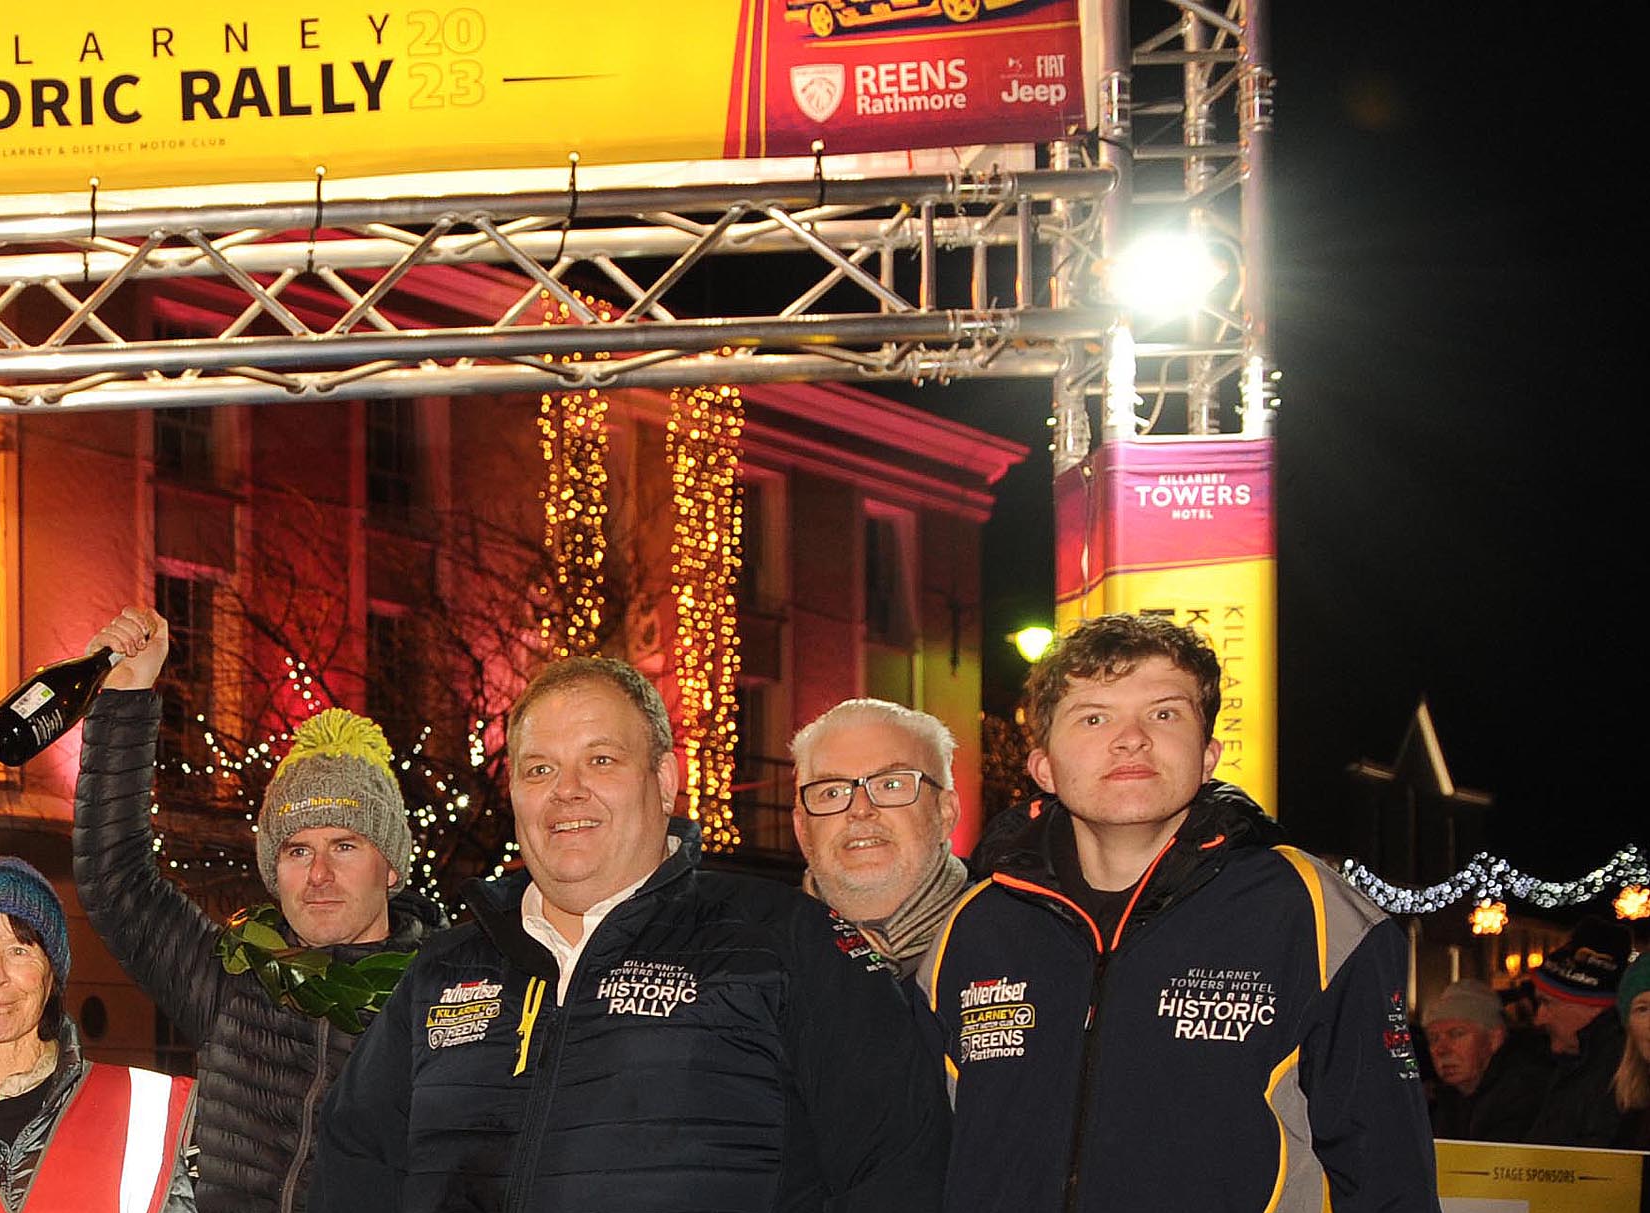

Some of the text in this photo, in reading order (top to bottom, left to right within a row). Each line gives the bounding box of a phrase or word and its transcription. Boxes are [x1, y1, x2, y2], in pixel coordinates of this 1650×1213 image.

[854, 58, 969, 95] REENS
[180, 58, 395, 121] RALLY
[1001, 79, 1068, 106] Jeep
[855, 92, 968, 116] Rathmore
[139, 139, 186, 151] MOTOR
[191, 138, 227, 148] CLUB
[1158, 472, 1226, 485] KILLARNEY
[1134, 484, 1252, 508] TOWERS
[1171, 508, 1214, 520] HOTEL
[1221, 605, 1245, 772] KILLARNEY
[623, 959, 686, 972] KILLARNEY
[1188, 967, 1262, 981] KILLARNEY
[658, 971, 697, 981] HOTEL
[1169, 977, 1275, 994] TOWERS HOTEL
[596, 981, 698, 1004] HISTORIC
[1160, 988, 1277, 1006] KILLARNEY
[607, 997, 678, 1018] RALLY
[1157, 998, 1276, 1026] HISTORIC
[971, 1029, 1025, 1049] REENS
[1174, 1019, 1254, 1042] RALLY
[969, 1046, 1025, 1062] Rathmore
[1493, 1166, 1524, 1181] STAGE
